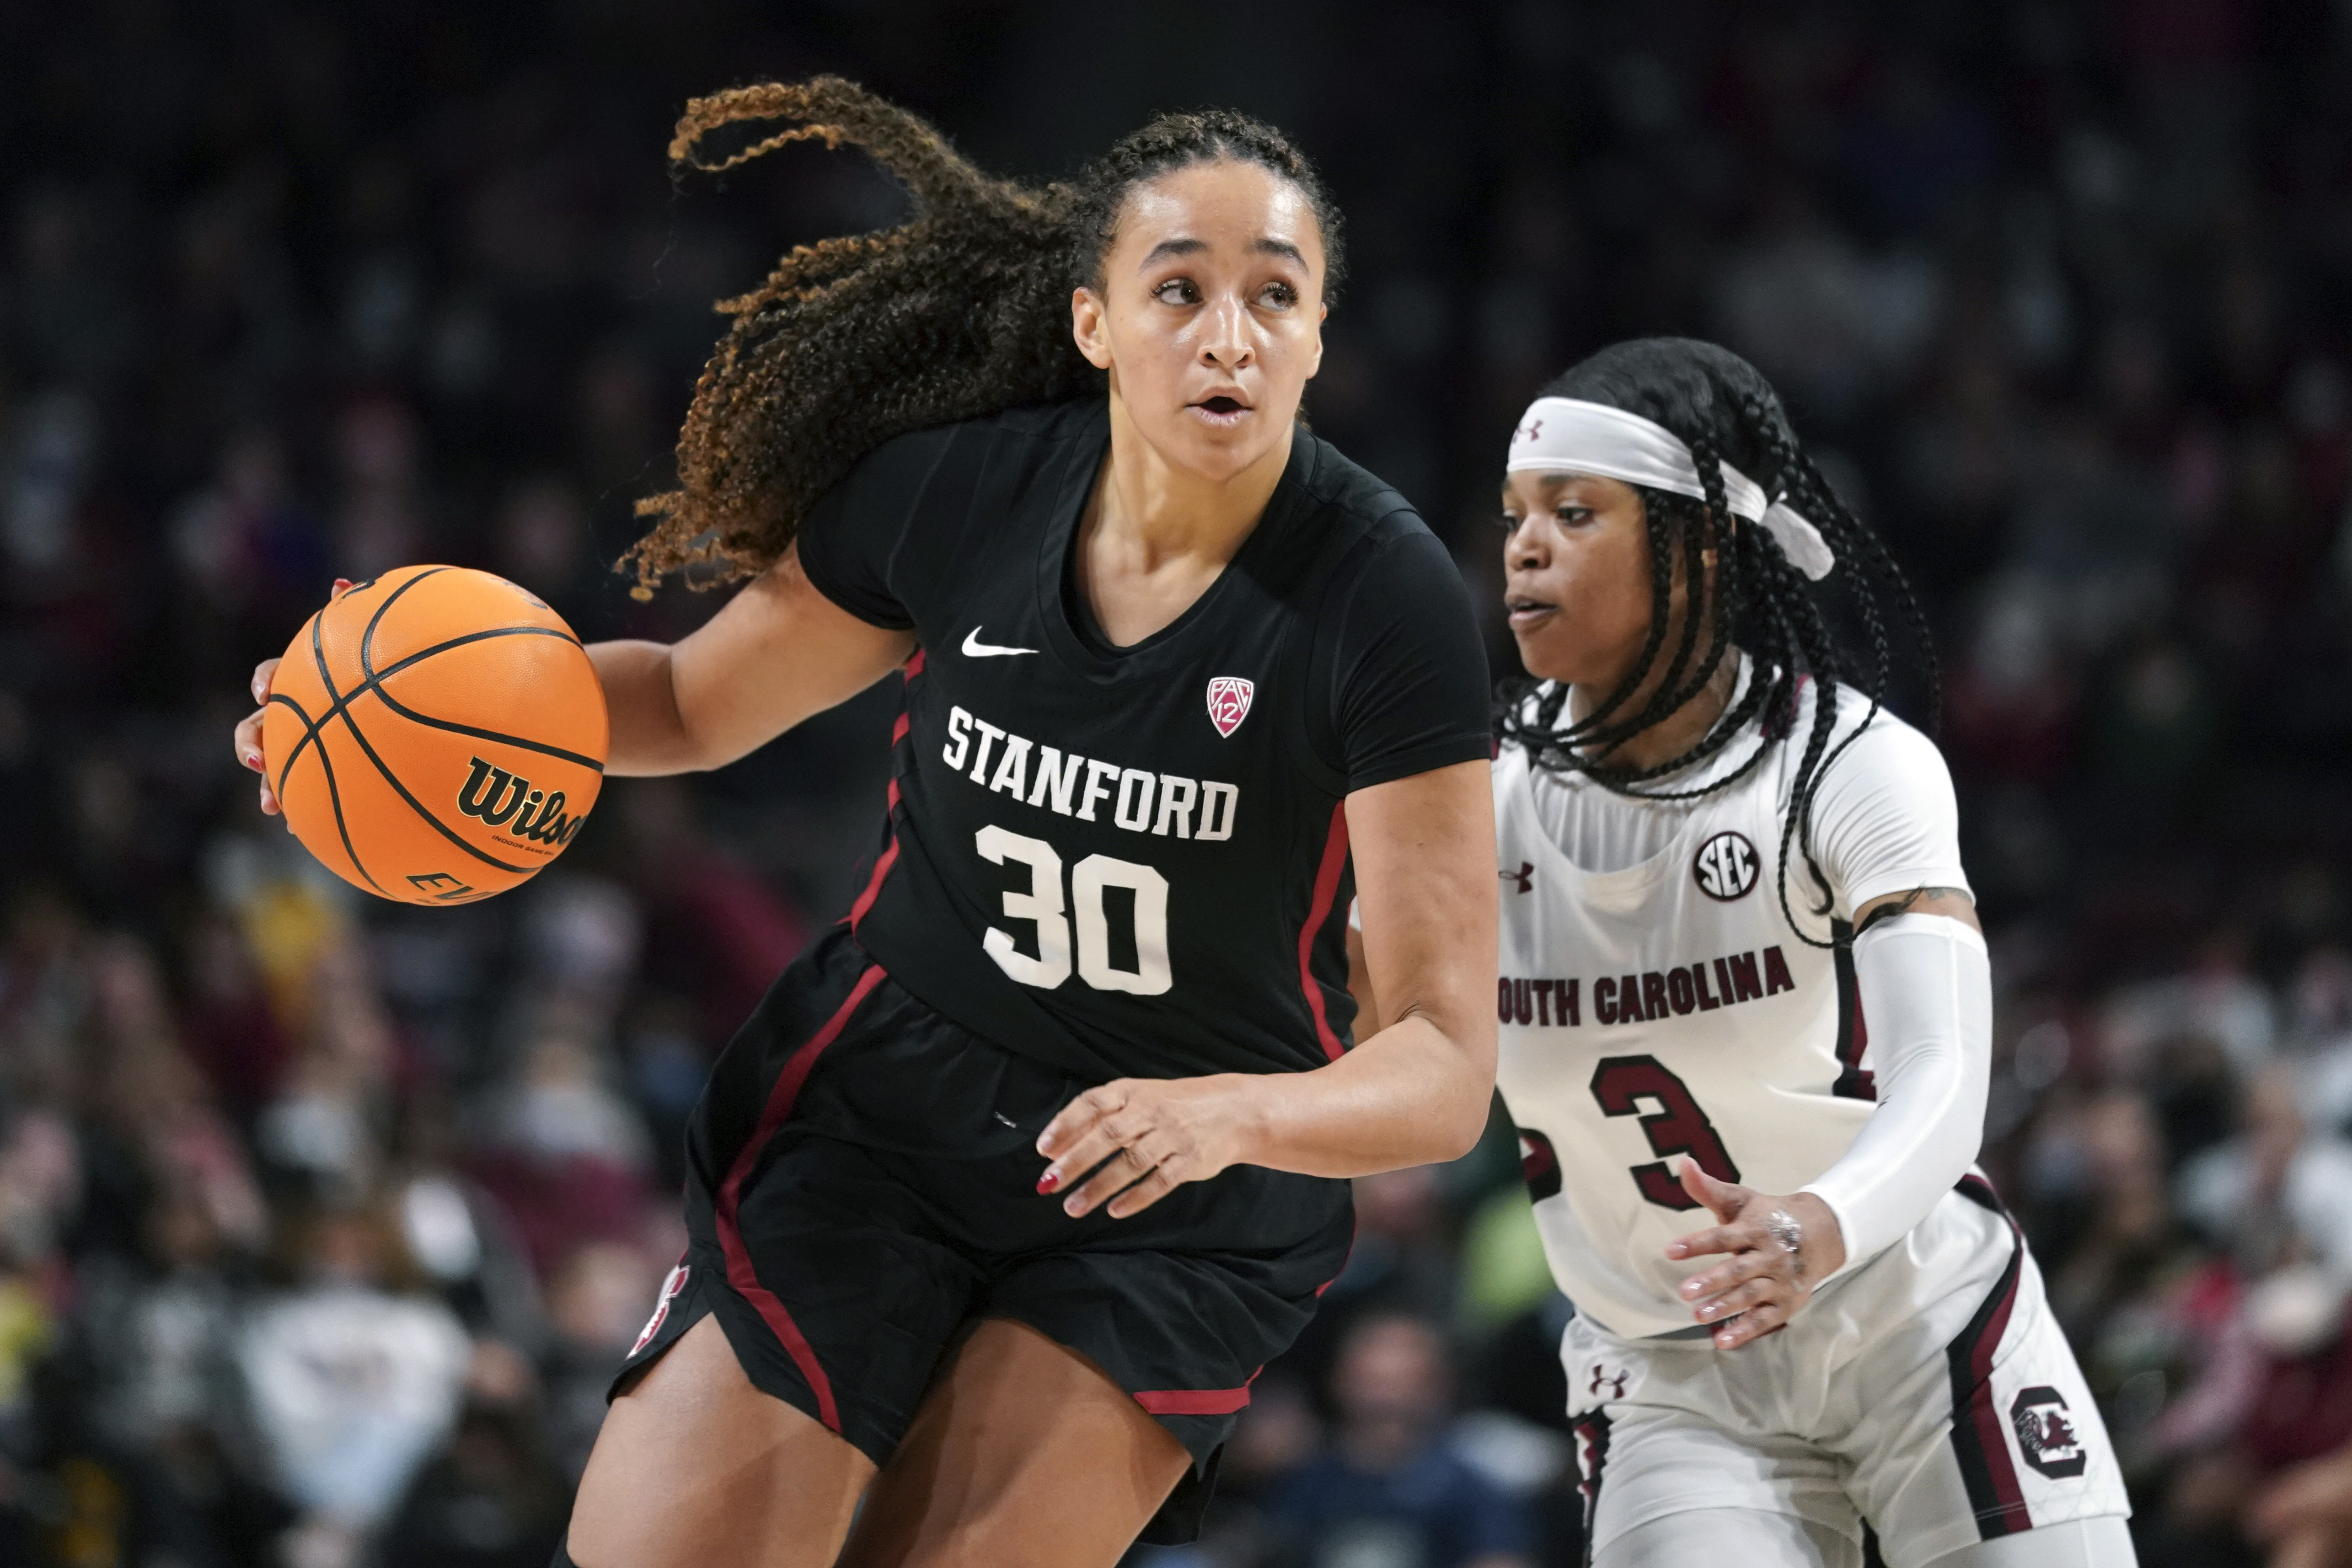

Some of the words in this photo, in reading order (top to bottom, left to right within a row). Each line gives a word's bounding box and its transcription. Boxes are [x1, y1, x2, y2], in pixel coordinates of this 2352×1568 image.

[1211, 680, 1251, 714] PAC
[1216, 702, 1239, 723] 12
[457, 755, 588, 846] Wilso
[943, 706, 1239, 841] STANFORD
[492, 835, 524, 849] INDOOR
[525, 846, 544, 855] GAME
[1697, 835, 1755, 897] SEC
[975, 824, 1173, 996] 30
[1497, 976, 1581, 1027] OUTH
[1593, 945, 1796, 1025] CAROLINA
[1589, 1054, 1741, 1211] 3
